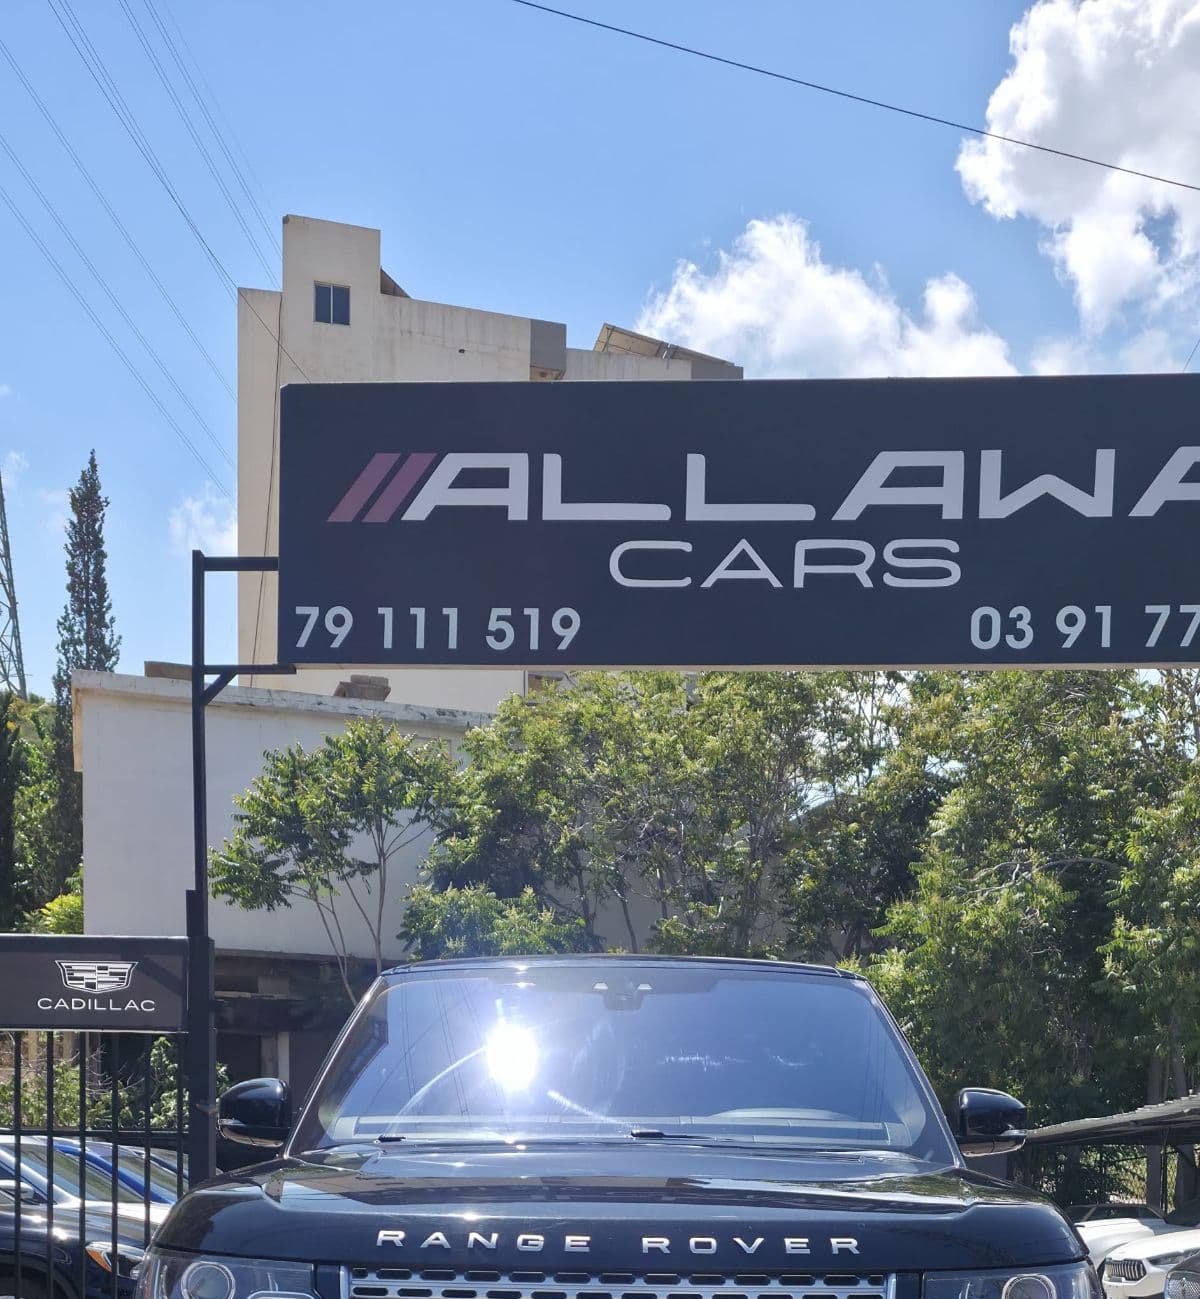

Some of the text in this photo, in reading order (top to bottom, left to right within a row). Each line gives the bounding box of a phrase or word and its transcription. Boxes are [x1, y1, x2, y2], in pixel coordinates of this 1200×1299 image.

[401, 446, 1200, 523] ALLAWA
[609, 538, 962, 589] CARS
[295, 606, 581, 650] 79 111 519
[970, 604, 1200, 649] 03 91 77
[37, 997, 156, 1012] CADILLAC
[375, 1229, 860, 1255] RANGE ROVER
